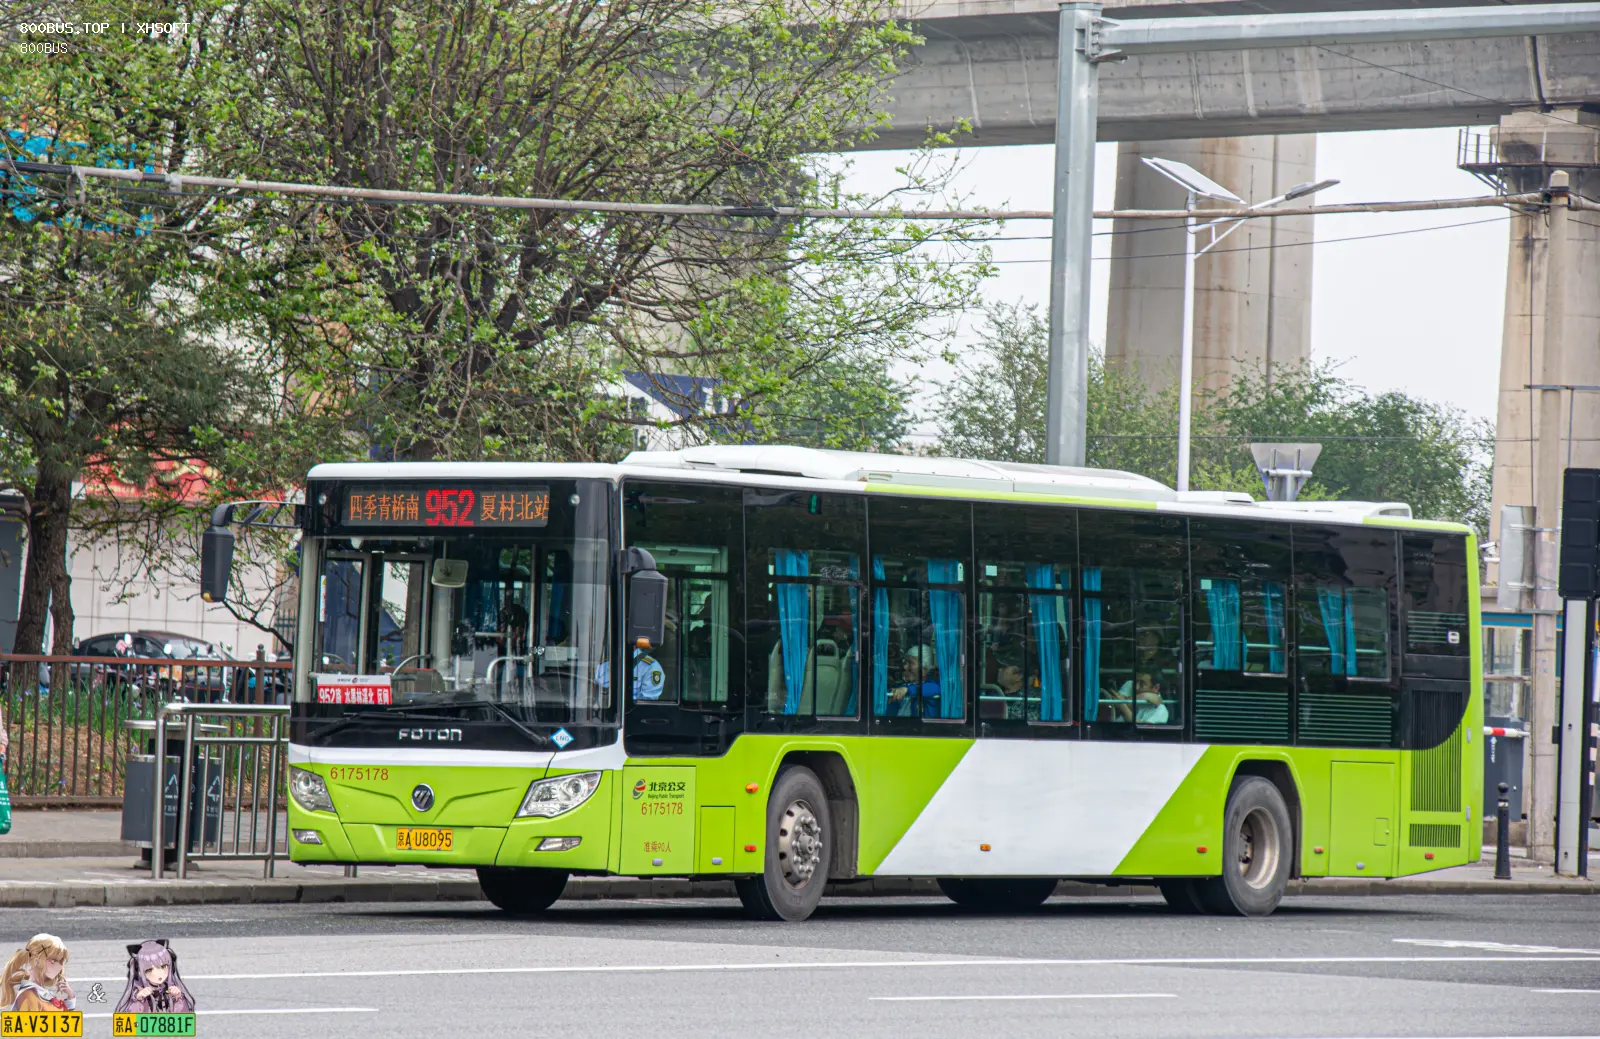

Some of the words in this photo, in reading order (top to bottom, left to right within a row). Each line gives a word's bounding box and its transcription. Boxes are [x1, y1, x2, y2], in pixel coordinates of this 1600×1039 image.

[349, 493, 419, 521] 四季青桥南
[425, 489, 475, 526] 952
[480, 493, 549, 522] 夏村北站
[398, 728, 462, 741] FOTON
[330, 767, 389, 781] 6175178
[648, 781, 686, 792] 北京公交
[641, 802, 683, 815] 6175178
